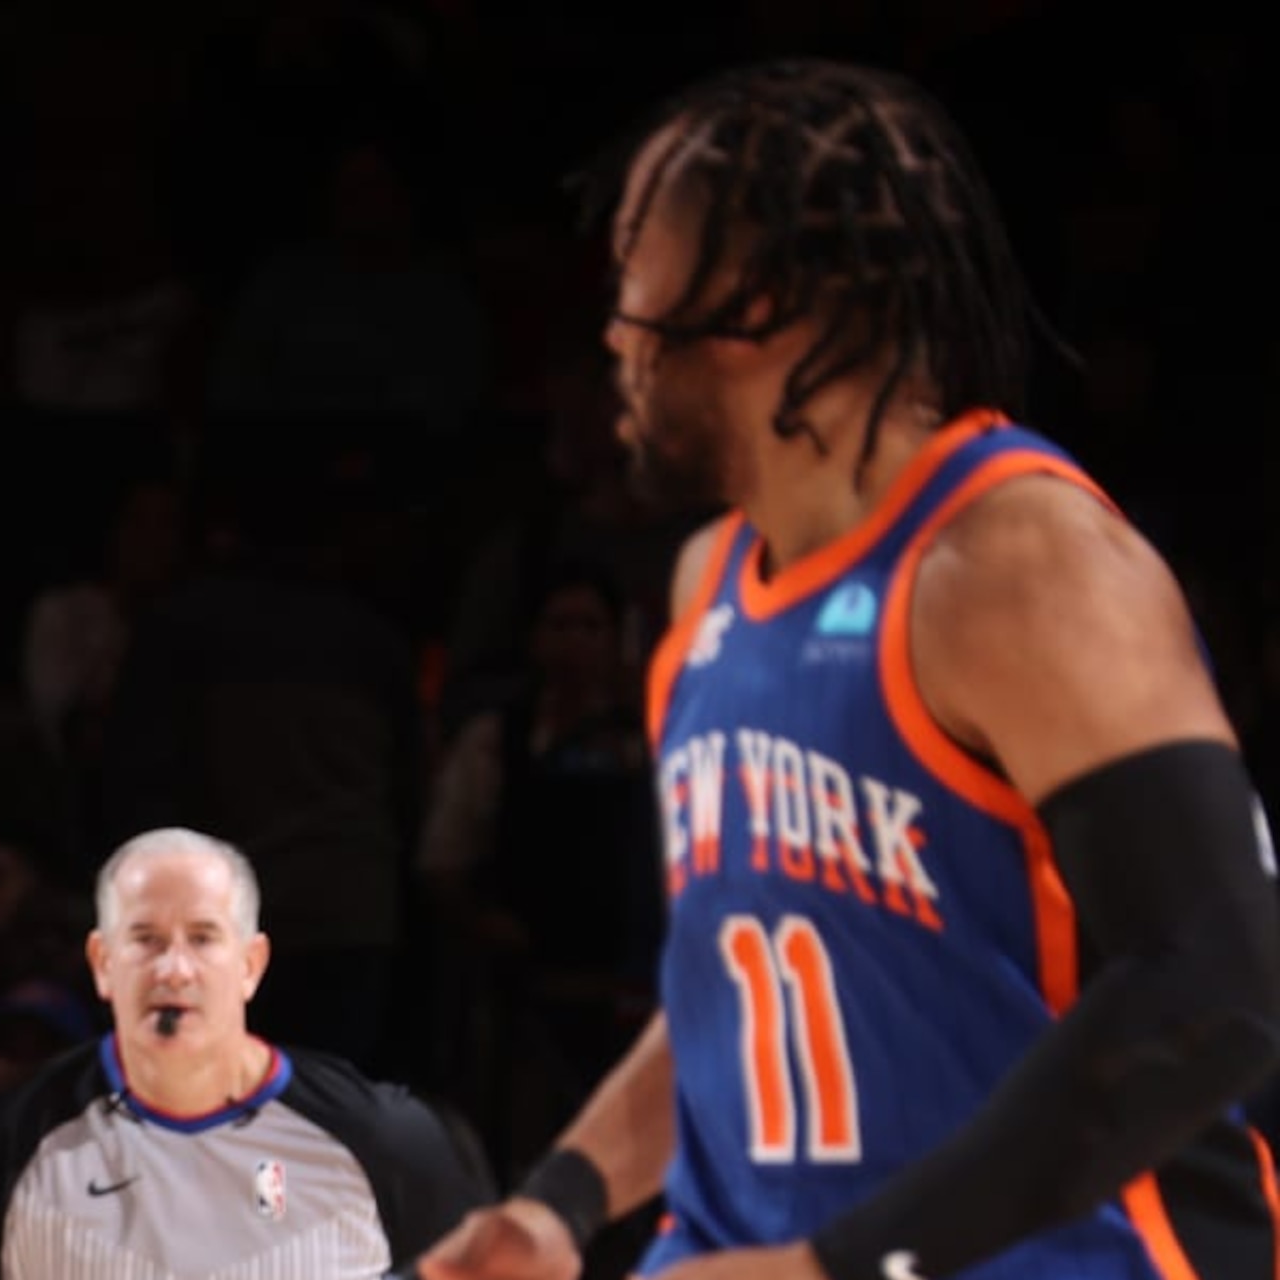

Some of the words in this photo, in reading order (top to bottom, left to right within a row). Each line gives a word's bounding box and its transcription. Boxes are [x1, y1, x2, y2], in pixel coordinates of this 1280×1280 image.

[659, 729, 726, 896] EW
[735, 727, 945, 933] YORK
[719, 915, 862, 1164] 11
